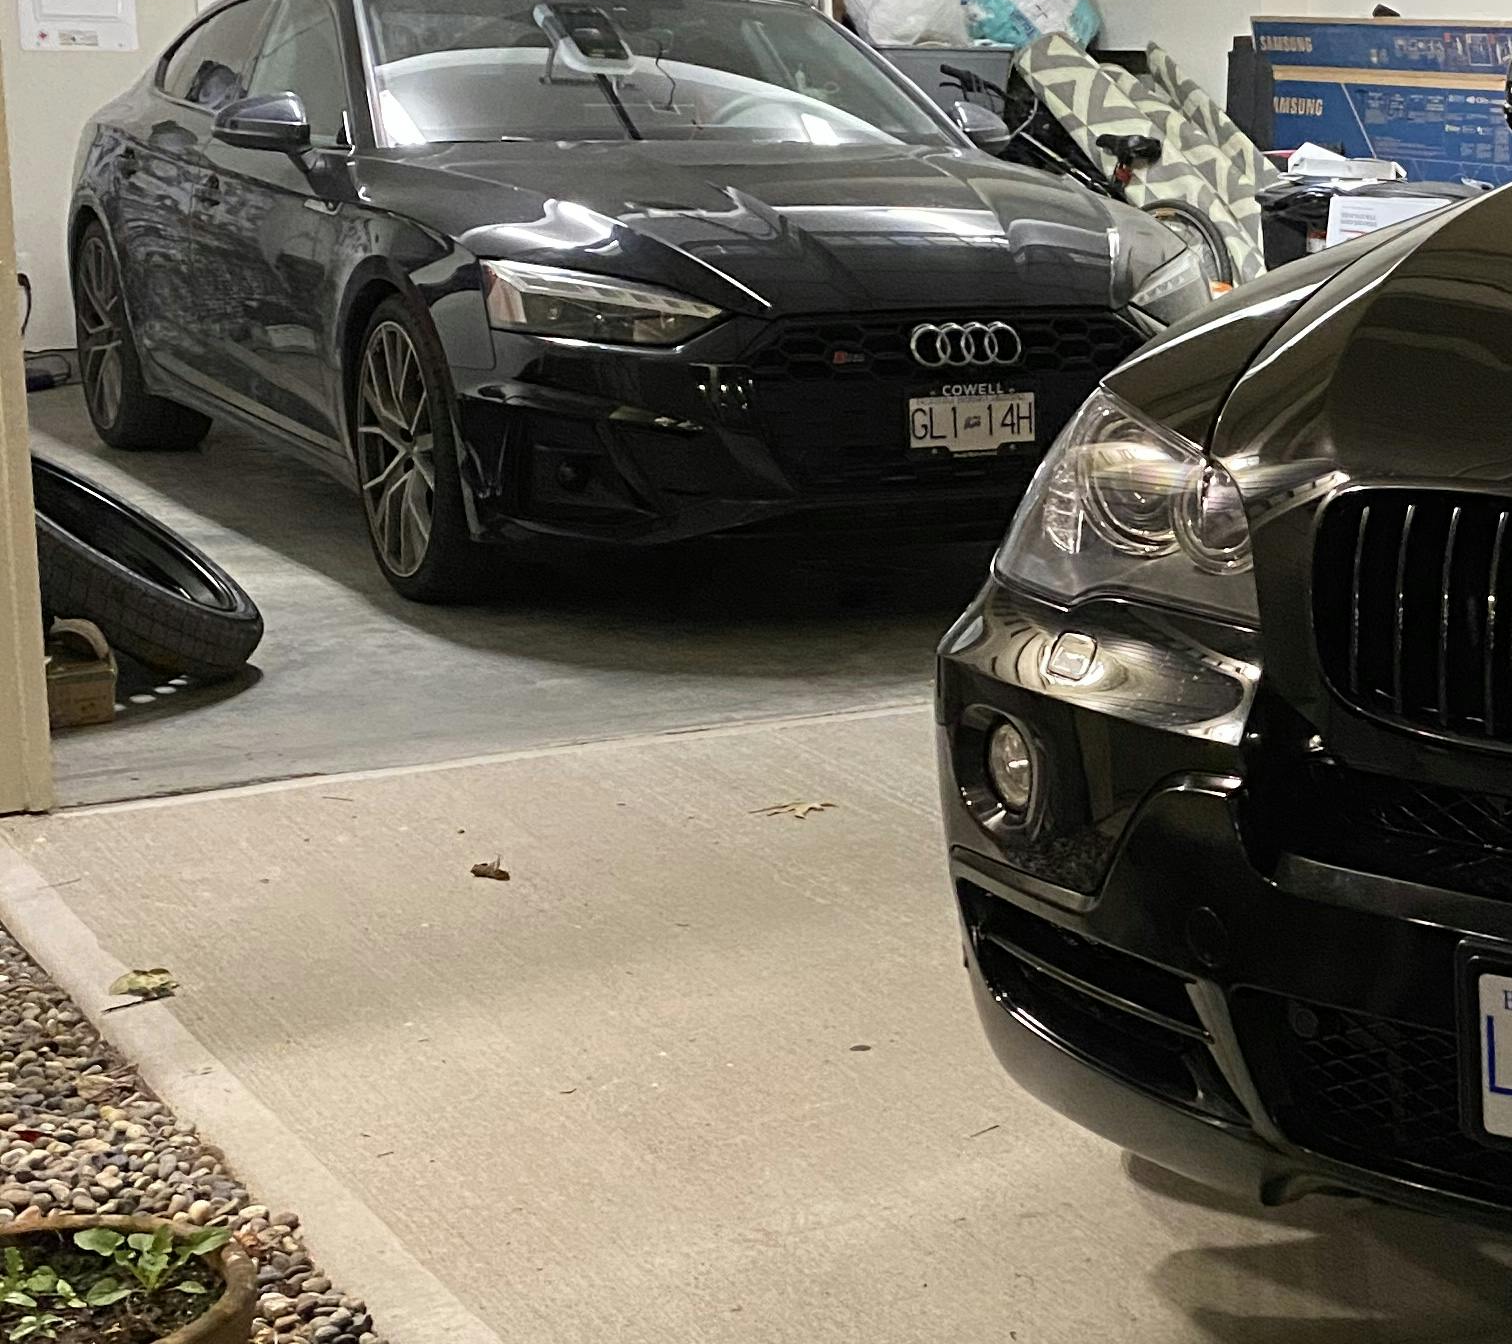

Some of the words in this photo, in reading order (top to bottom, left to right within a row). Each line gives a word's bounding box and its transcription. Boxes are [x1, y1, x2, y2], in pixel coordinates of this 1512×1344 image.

[1260, 36, 1313, 53] SAMSUNG
[1272, 96, 1323, 116] AMSUNG
[942, 382, 1005, 396] COWELL
